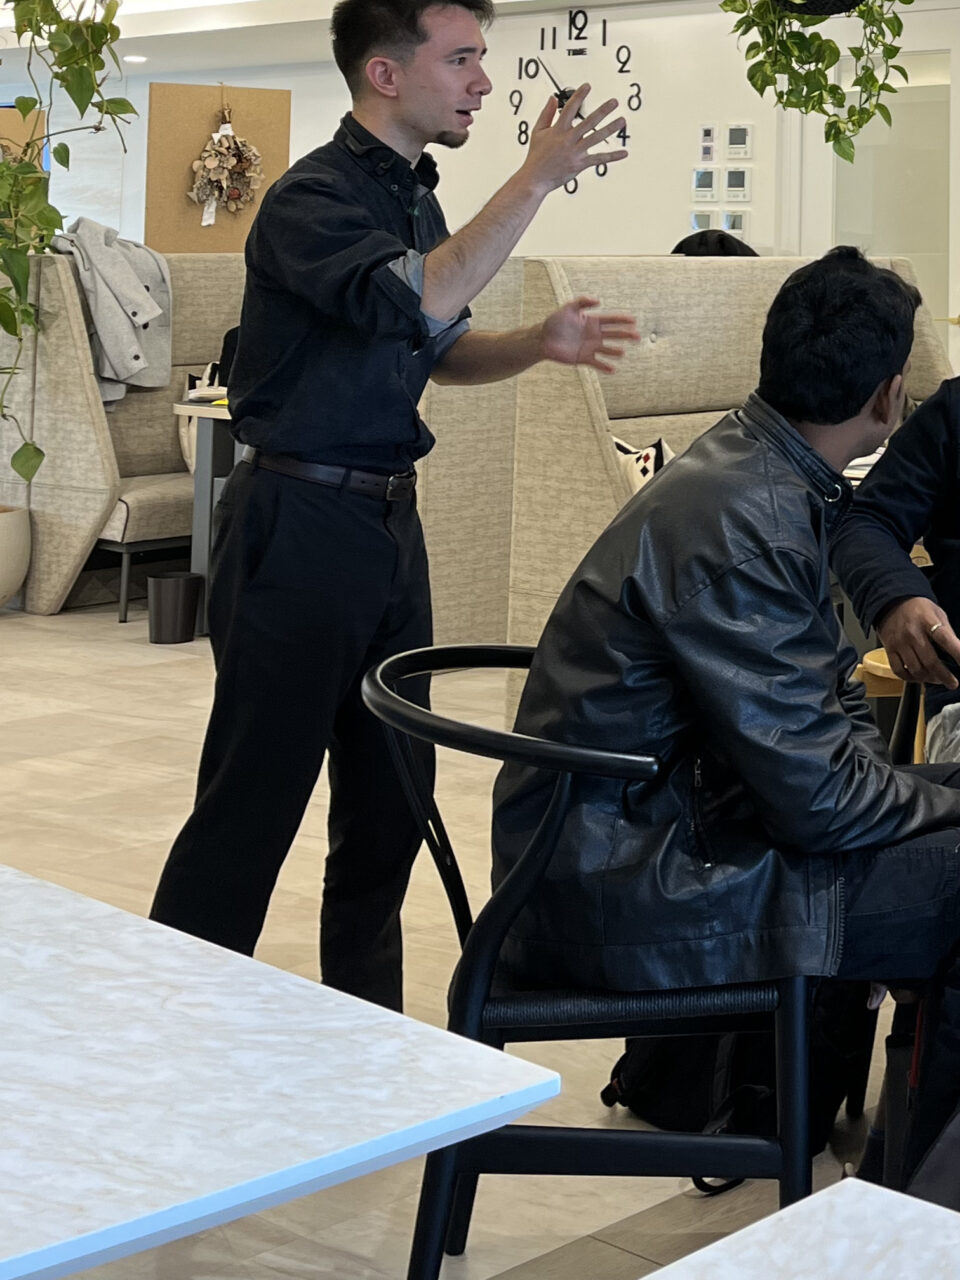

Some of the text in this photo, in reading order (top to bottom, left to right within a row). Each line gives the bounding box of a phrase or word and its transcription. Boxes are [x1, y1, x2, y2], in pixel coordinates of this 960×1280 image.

[568, 10, 588, 40] 12
[602, 19, 607, 47] 1
[540, 27, 557, 50] 11
[518, 57, 540, 79] 10
[616, 45, 631, 73] 2
[509, 89, 523, 115] 9
[627, 83, 642, 111] 3
[517, 121, 529, 145] 8
[616, 124, 631, 147] 4
